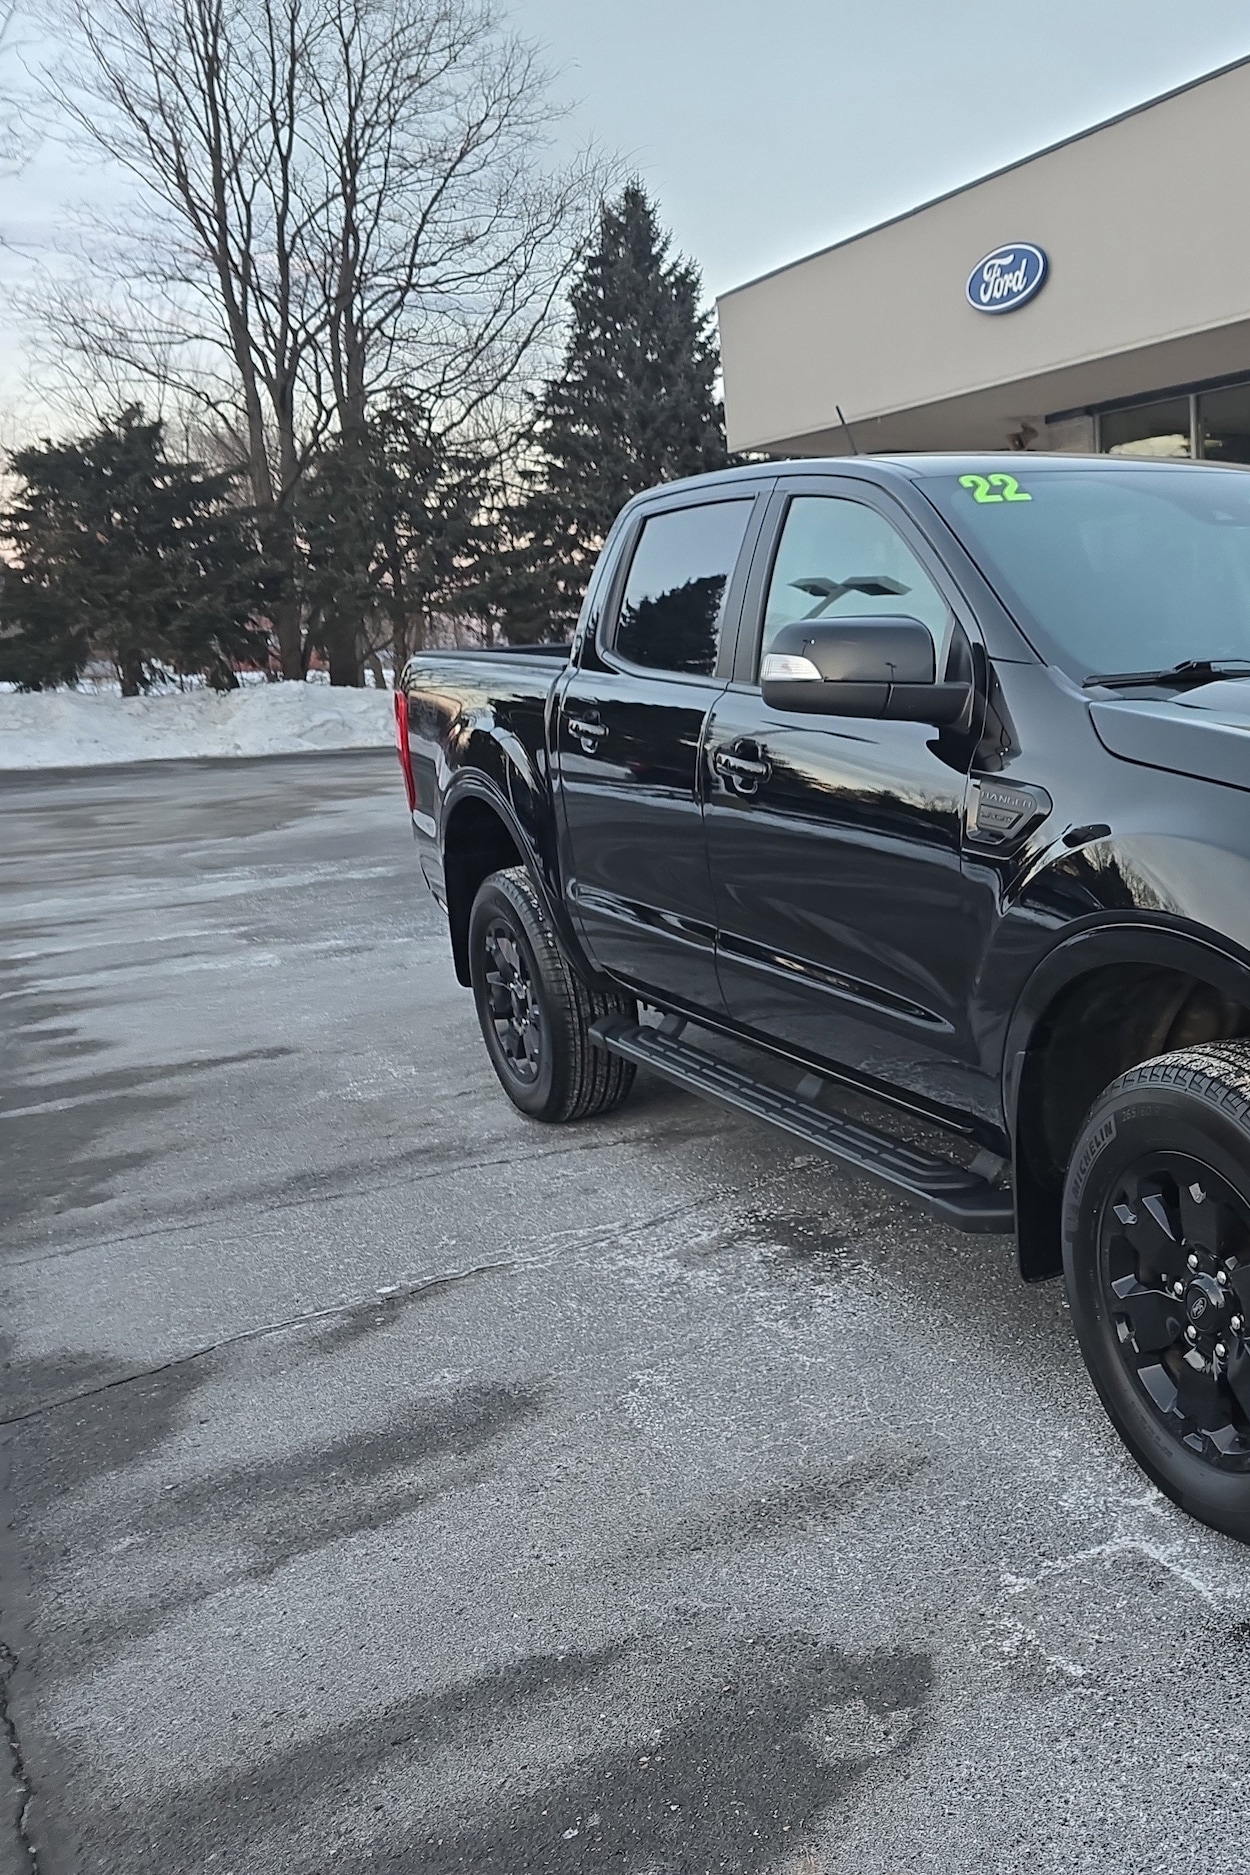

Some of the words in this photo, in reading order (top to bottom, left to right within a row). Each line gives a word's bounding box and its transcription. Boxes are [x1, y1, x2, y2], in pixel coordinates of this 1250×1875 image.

[979, 253, 1028, 304] Ford
[958, 473, 1032, 503] 22
[1071, 1120, 1114, 1200] MICHELIN
